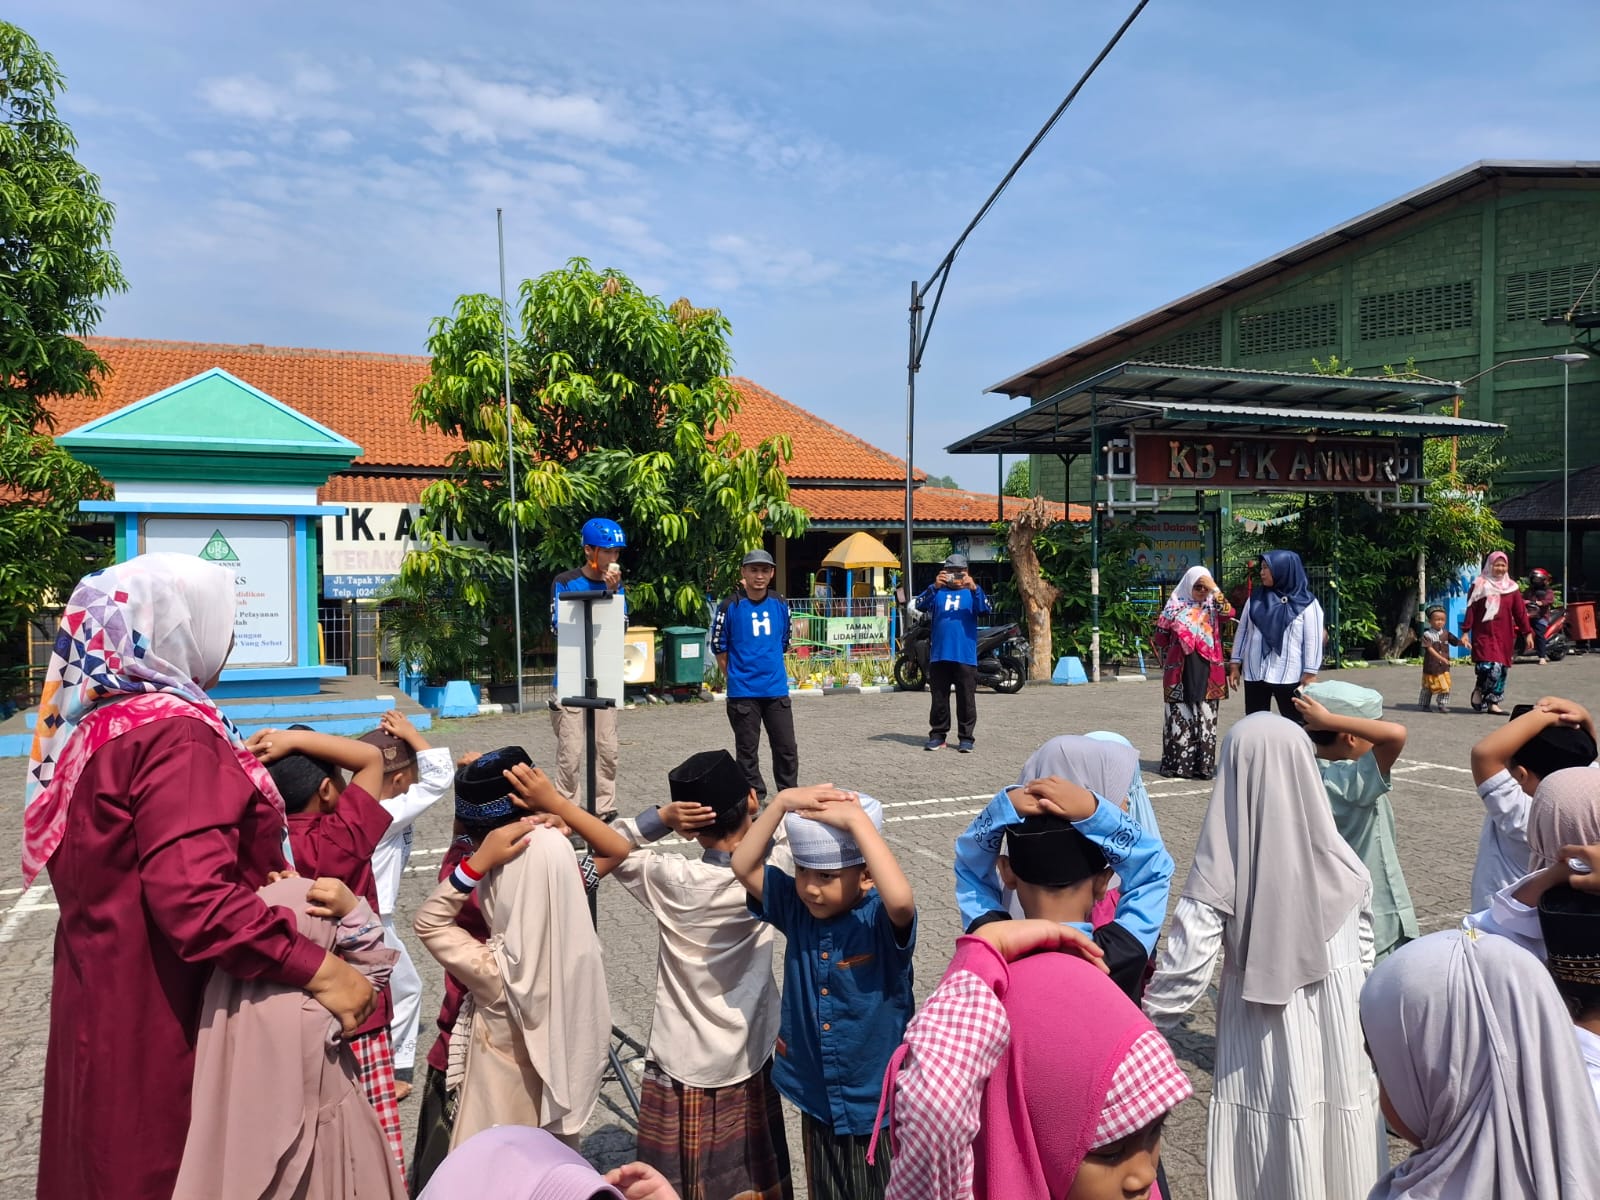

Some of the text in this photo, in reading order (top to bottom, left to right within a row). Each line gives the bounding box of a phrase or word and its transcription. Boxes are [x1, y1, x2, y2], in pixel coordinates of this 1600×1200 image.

[1168, 440, 1280, 480] KB-TK
[332, 549, 402, 570] TERAK
[347, 576, 373, 586] Tapak
[332, 588, 354, 598] Telp.
[845, 623, 873, 631] TAMAN
[833, 632, 857, 641] LIDAH
